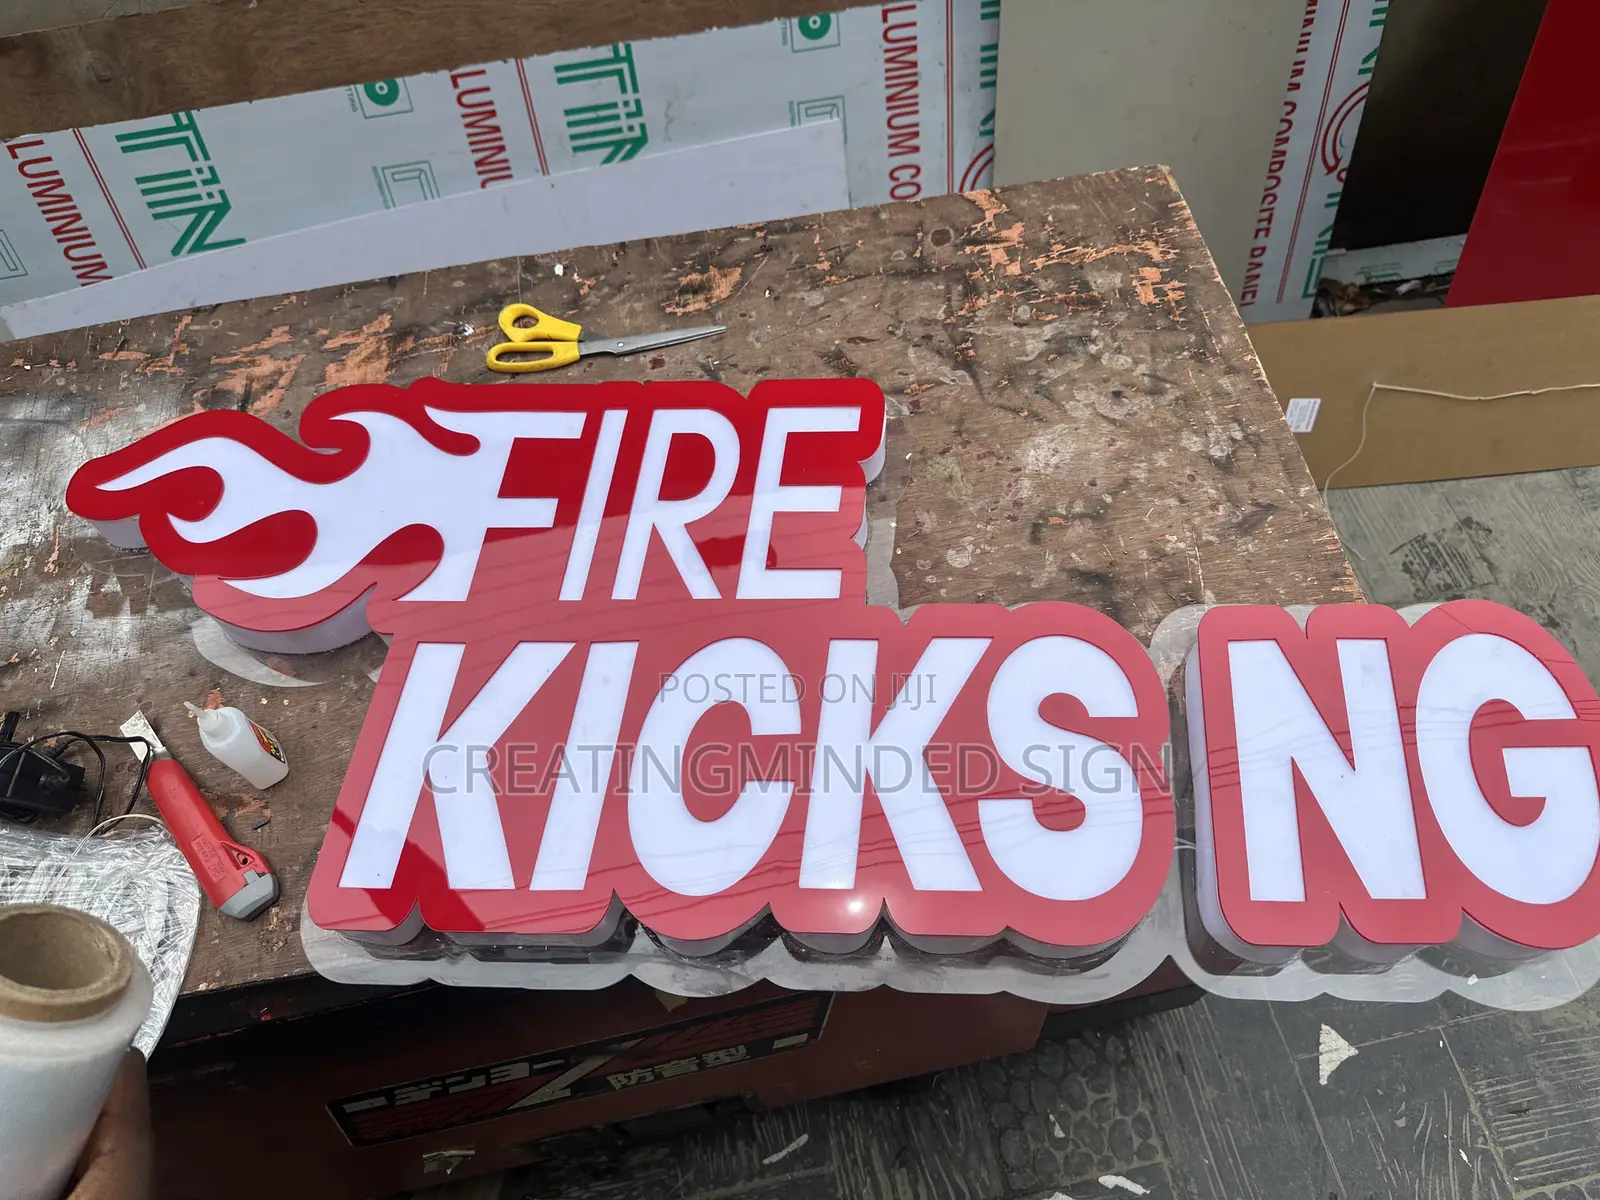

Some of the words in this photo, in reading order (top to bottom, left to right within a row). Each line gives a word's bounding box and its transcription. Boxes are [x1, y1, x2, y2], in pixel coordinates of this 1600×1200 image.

[395, 404, 862, 602] FIRE
[338, 634, 1144, 900] KICKS
[1227, 632, 1600, 904] NG
